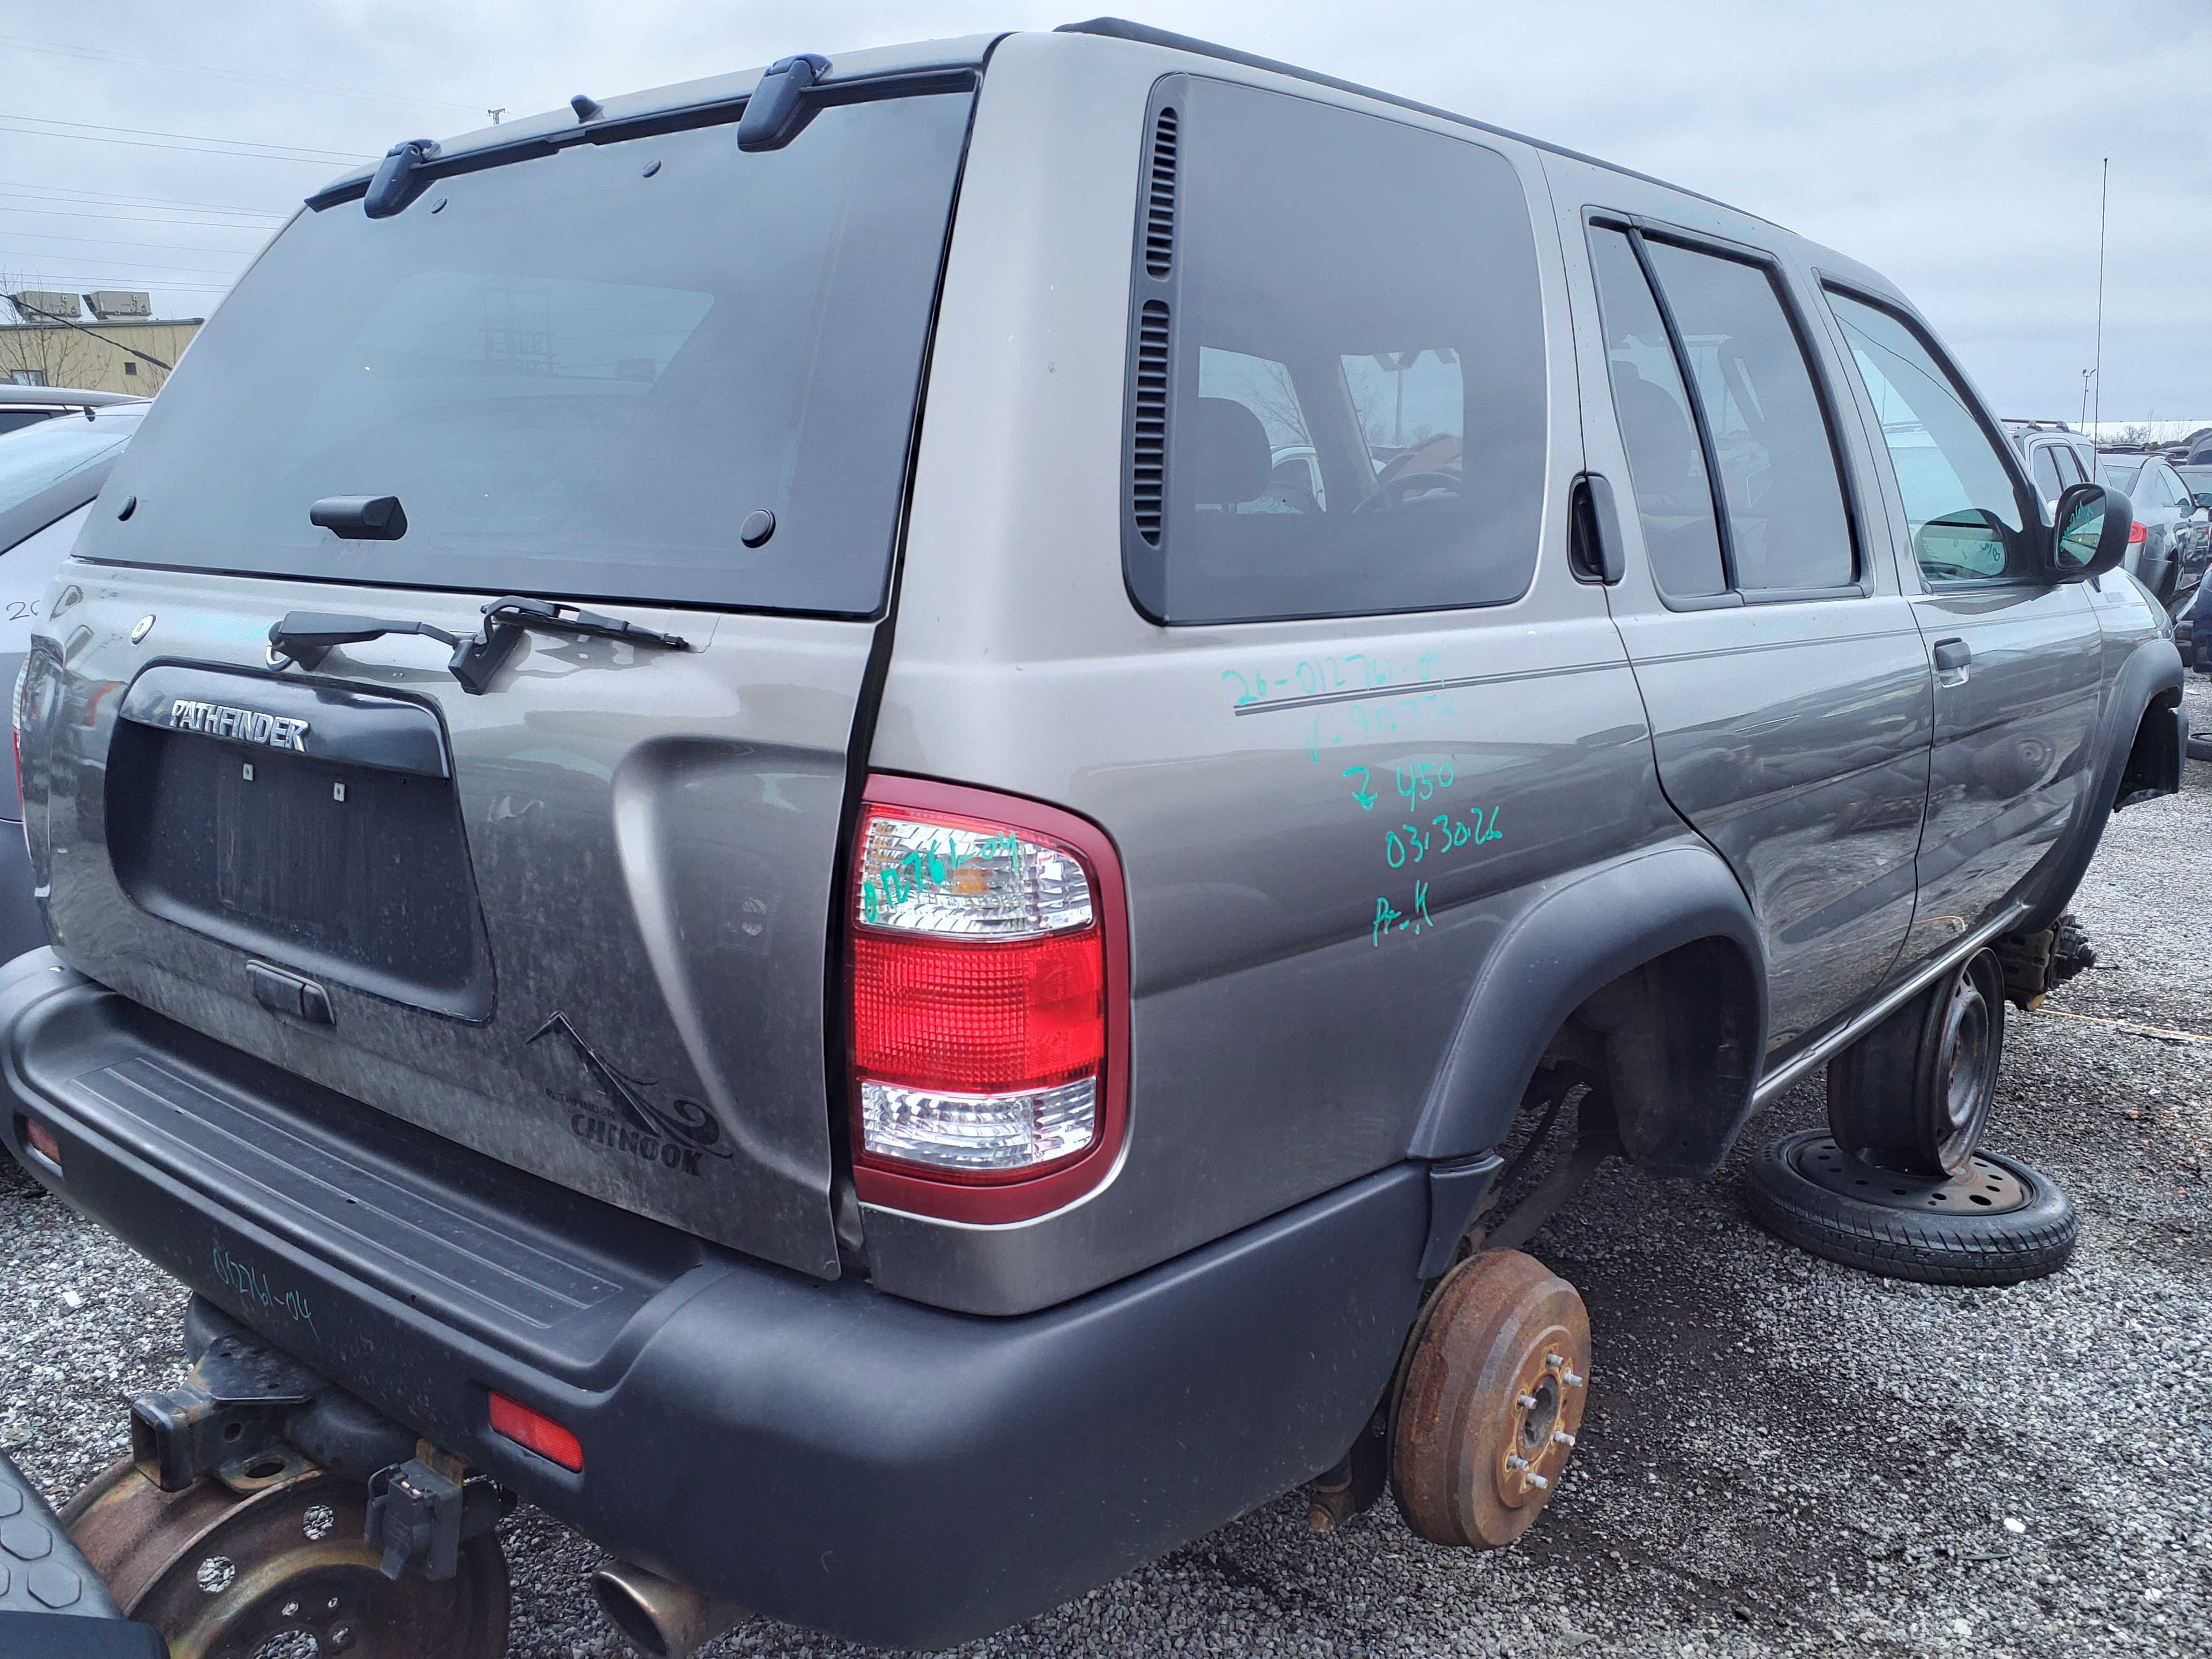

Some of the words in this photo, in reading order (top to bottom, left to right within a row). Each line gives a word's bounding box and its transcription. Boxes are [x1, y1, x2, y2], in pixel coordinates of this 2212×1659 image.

[171, 700, 309, 752] PATHFINDER
[1397, 763, 1454, 812] 450
[571, 1114, 704, 1177] CHINOOK
